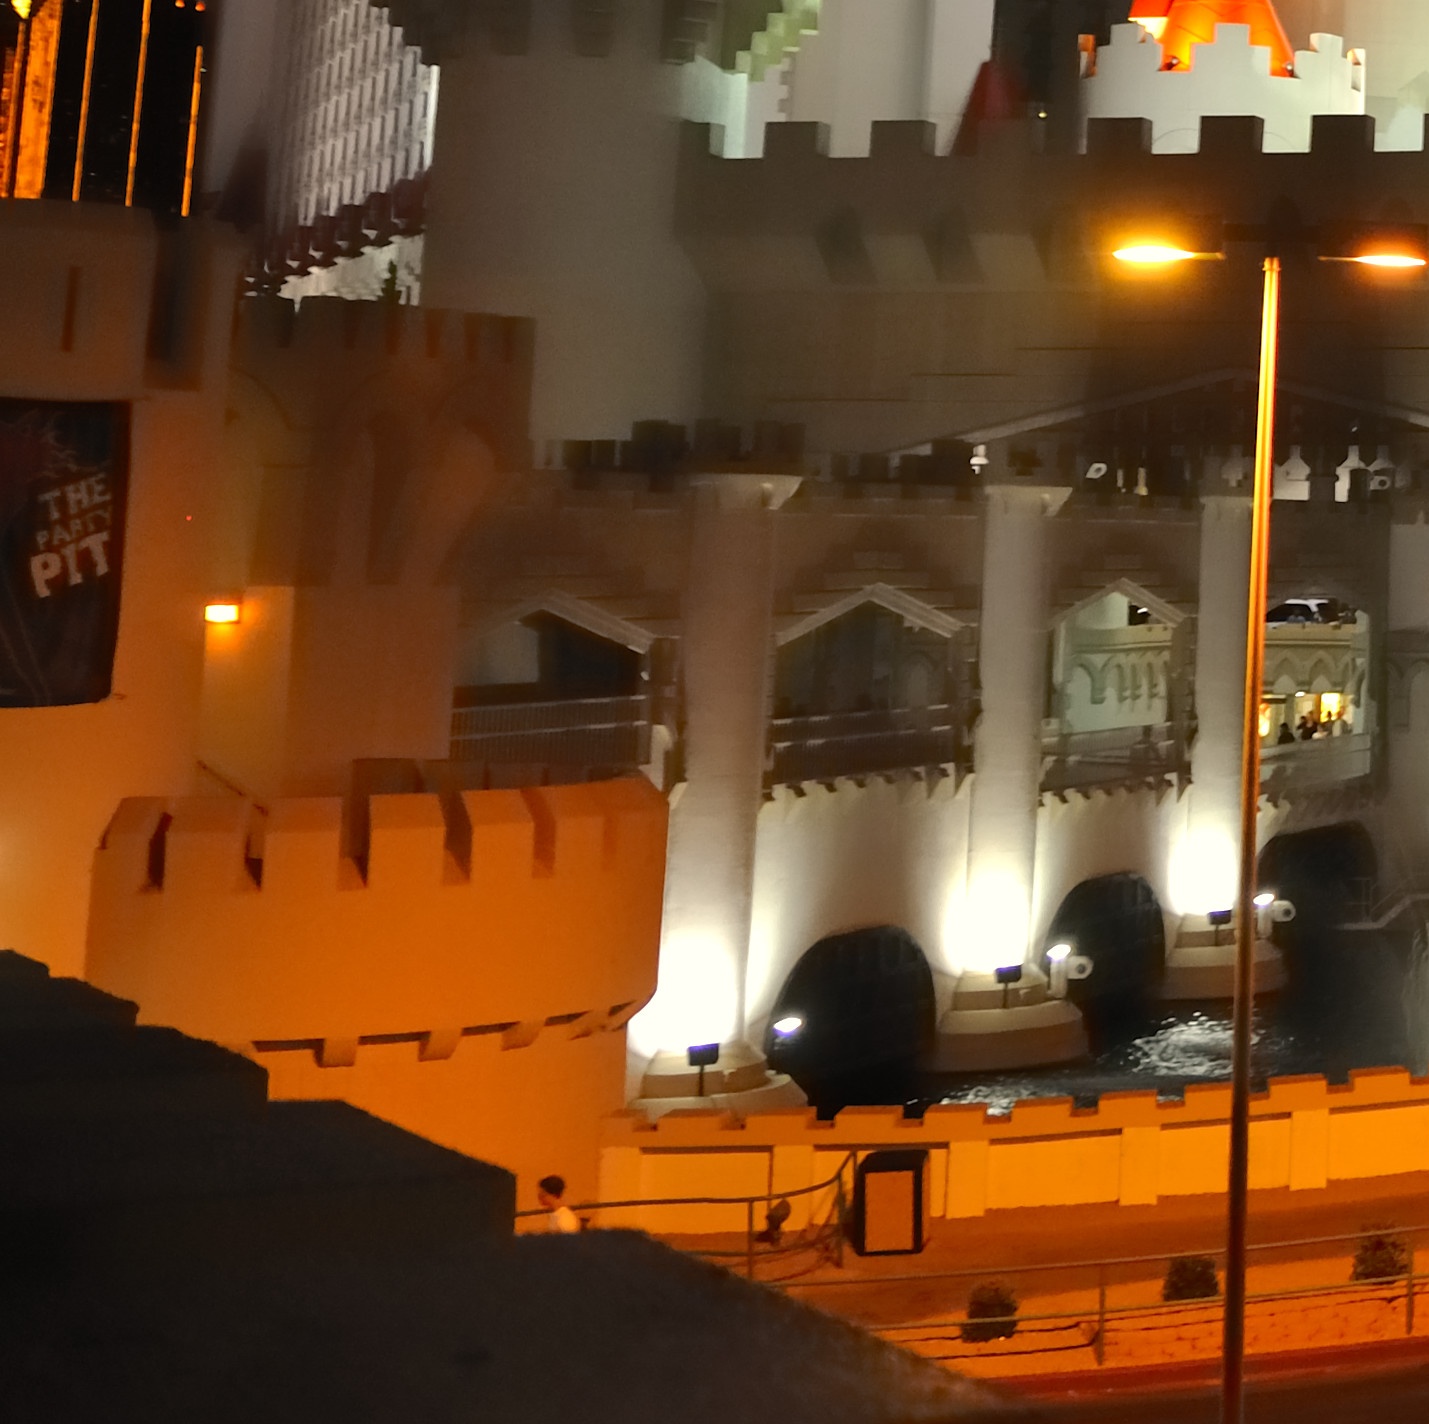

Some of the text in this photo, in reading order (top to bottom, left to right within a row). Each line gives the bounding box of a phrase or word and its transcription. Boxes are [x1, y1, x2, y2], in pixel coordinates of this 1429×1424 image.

[37, 472, 113, 522] THE
[35, 506, 113, 552] PARTY
[30, 530, 111, 599] PIT
